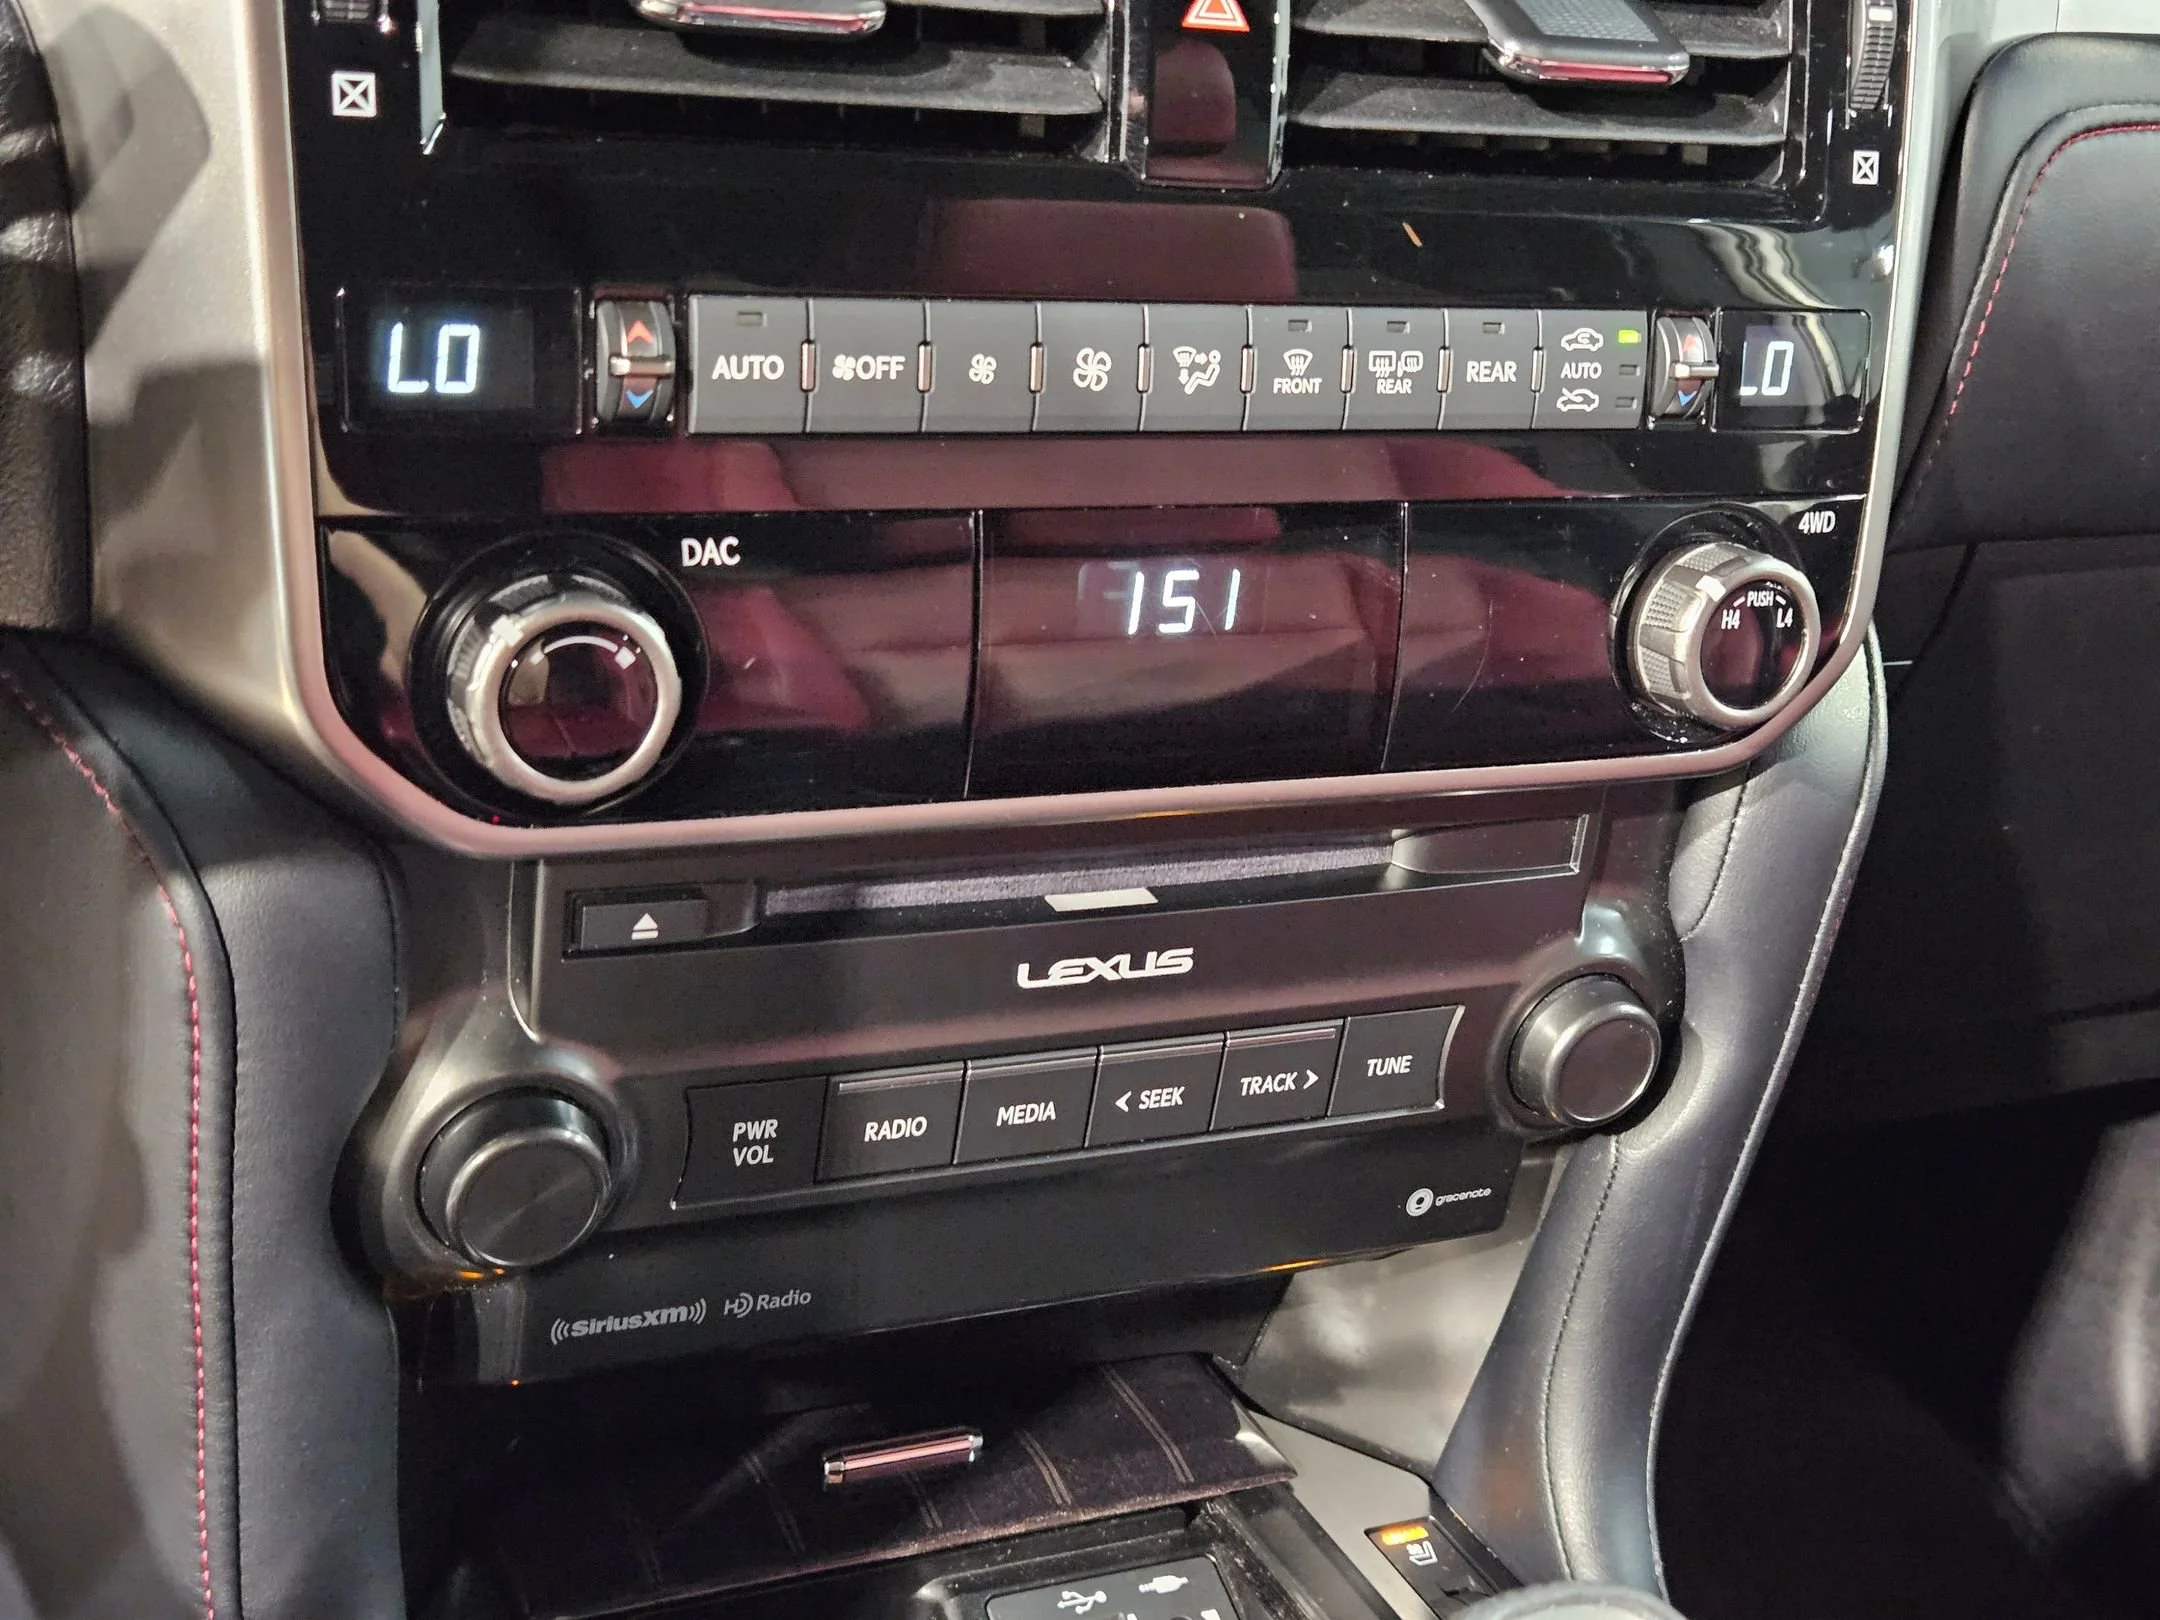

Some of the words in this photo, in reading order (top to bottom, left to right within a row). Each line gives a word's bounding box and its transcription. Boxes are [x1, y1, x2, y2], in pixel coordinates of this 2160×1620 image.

[387, 322, 481, 394] LO
[712, 355, 784, 380] AUTO
[857, 355, 905, 379] OFF
[1466, 361, 1518, 383] REAR
[1561, 362, 1602, 379] AUTO
[1273, 377, 1322, 395] FRONT
[1376, 378, 1412, 394] REAR
[1799, 510, 1836, 535] 4WD
[681, 536, 740, 566] DAC
[1746, 590, 1775, 608] PUSH
[1720, 609, 1741, 630] H4
[1775, 607, 1793, 628] L4
[1016, 947, 1193, 990] LEXUS
[1367, 1055, 1413, 1077] TUNE
[1240, 1072, 1297, 1097] TRACK
[1138, 1086, 1185, 1110] SEEK
[997, 1101, 1056, 1126] MEDIA
[732, 1119, 778, 1143] PWR
[864, 1116, 928, 1142] RADIO
[732, 1144, 775, 1167] VOL
[757, 1290, 812, 1311] Radio
